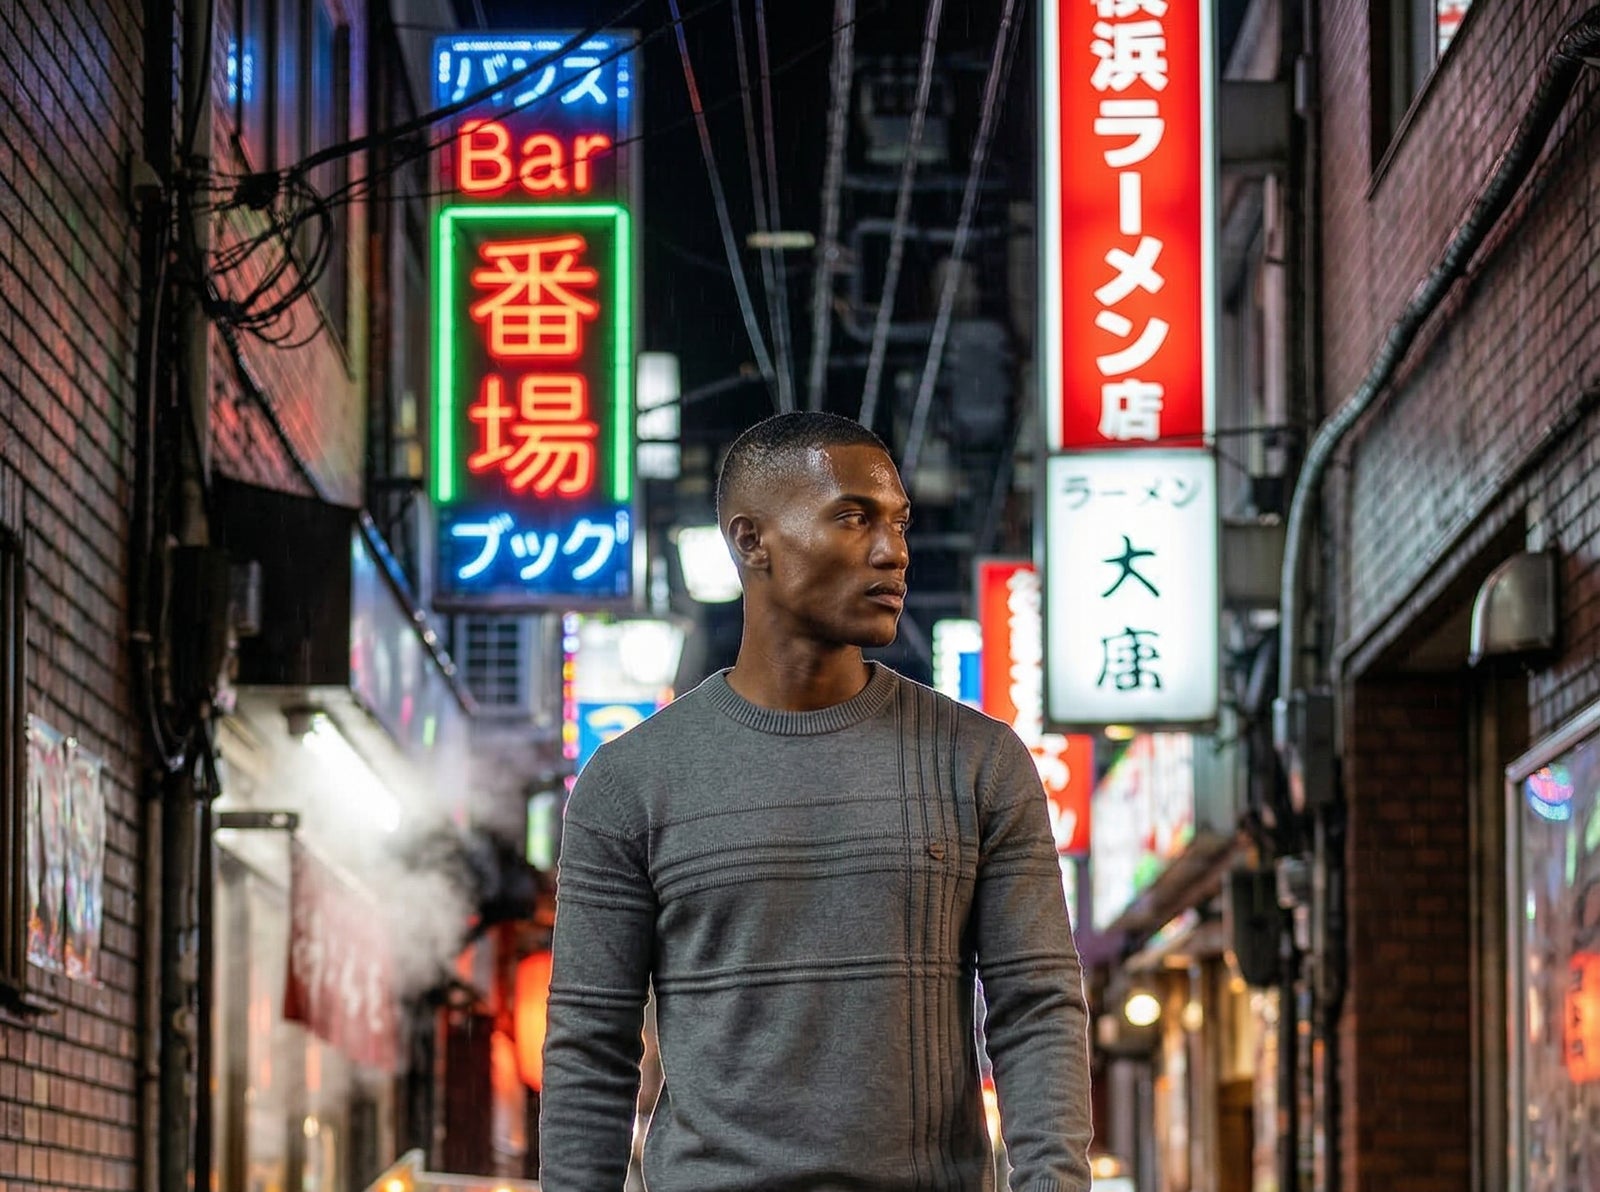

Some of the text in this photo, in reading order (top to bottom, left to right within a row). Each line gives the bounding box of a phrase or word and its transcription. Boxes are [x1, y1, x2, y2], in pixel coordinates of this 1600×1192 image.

[457, 117, 612, 194] Bar
[470, 234, 599, 496] 番場
[1062, 476, 1202, 511] ラーメン
[451, 511, 616, 581] ブック
